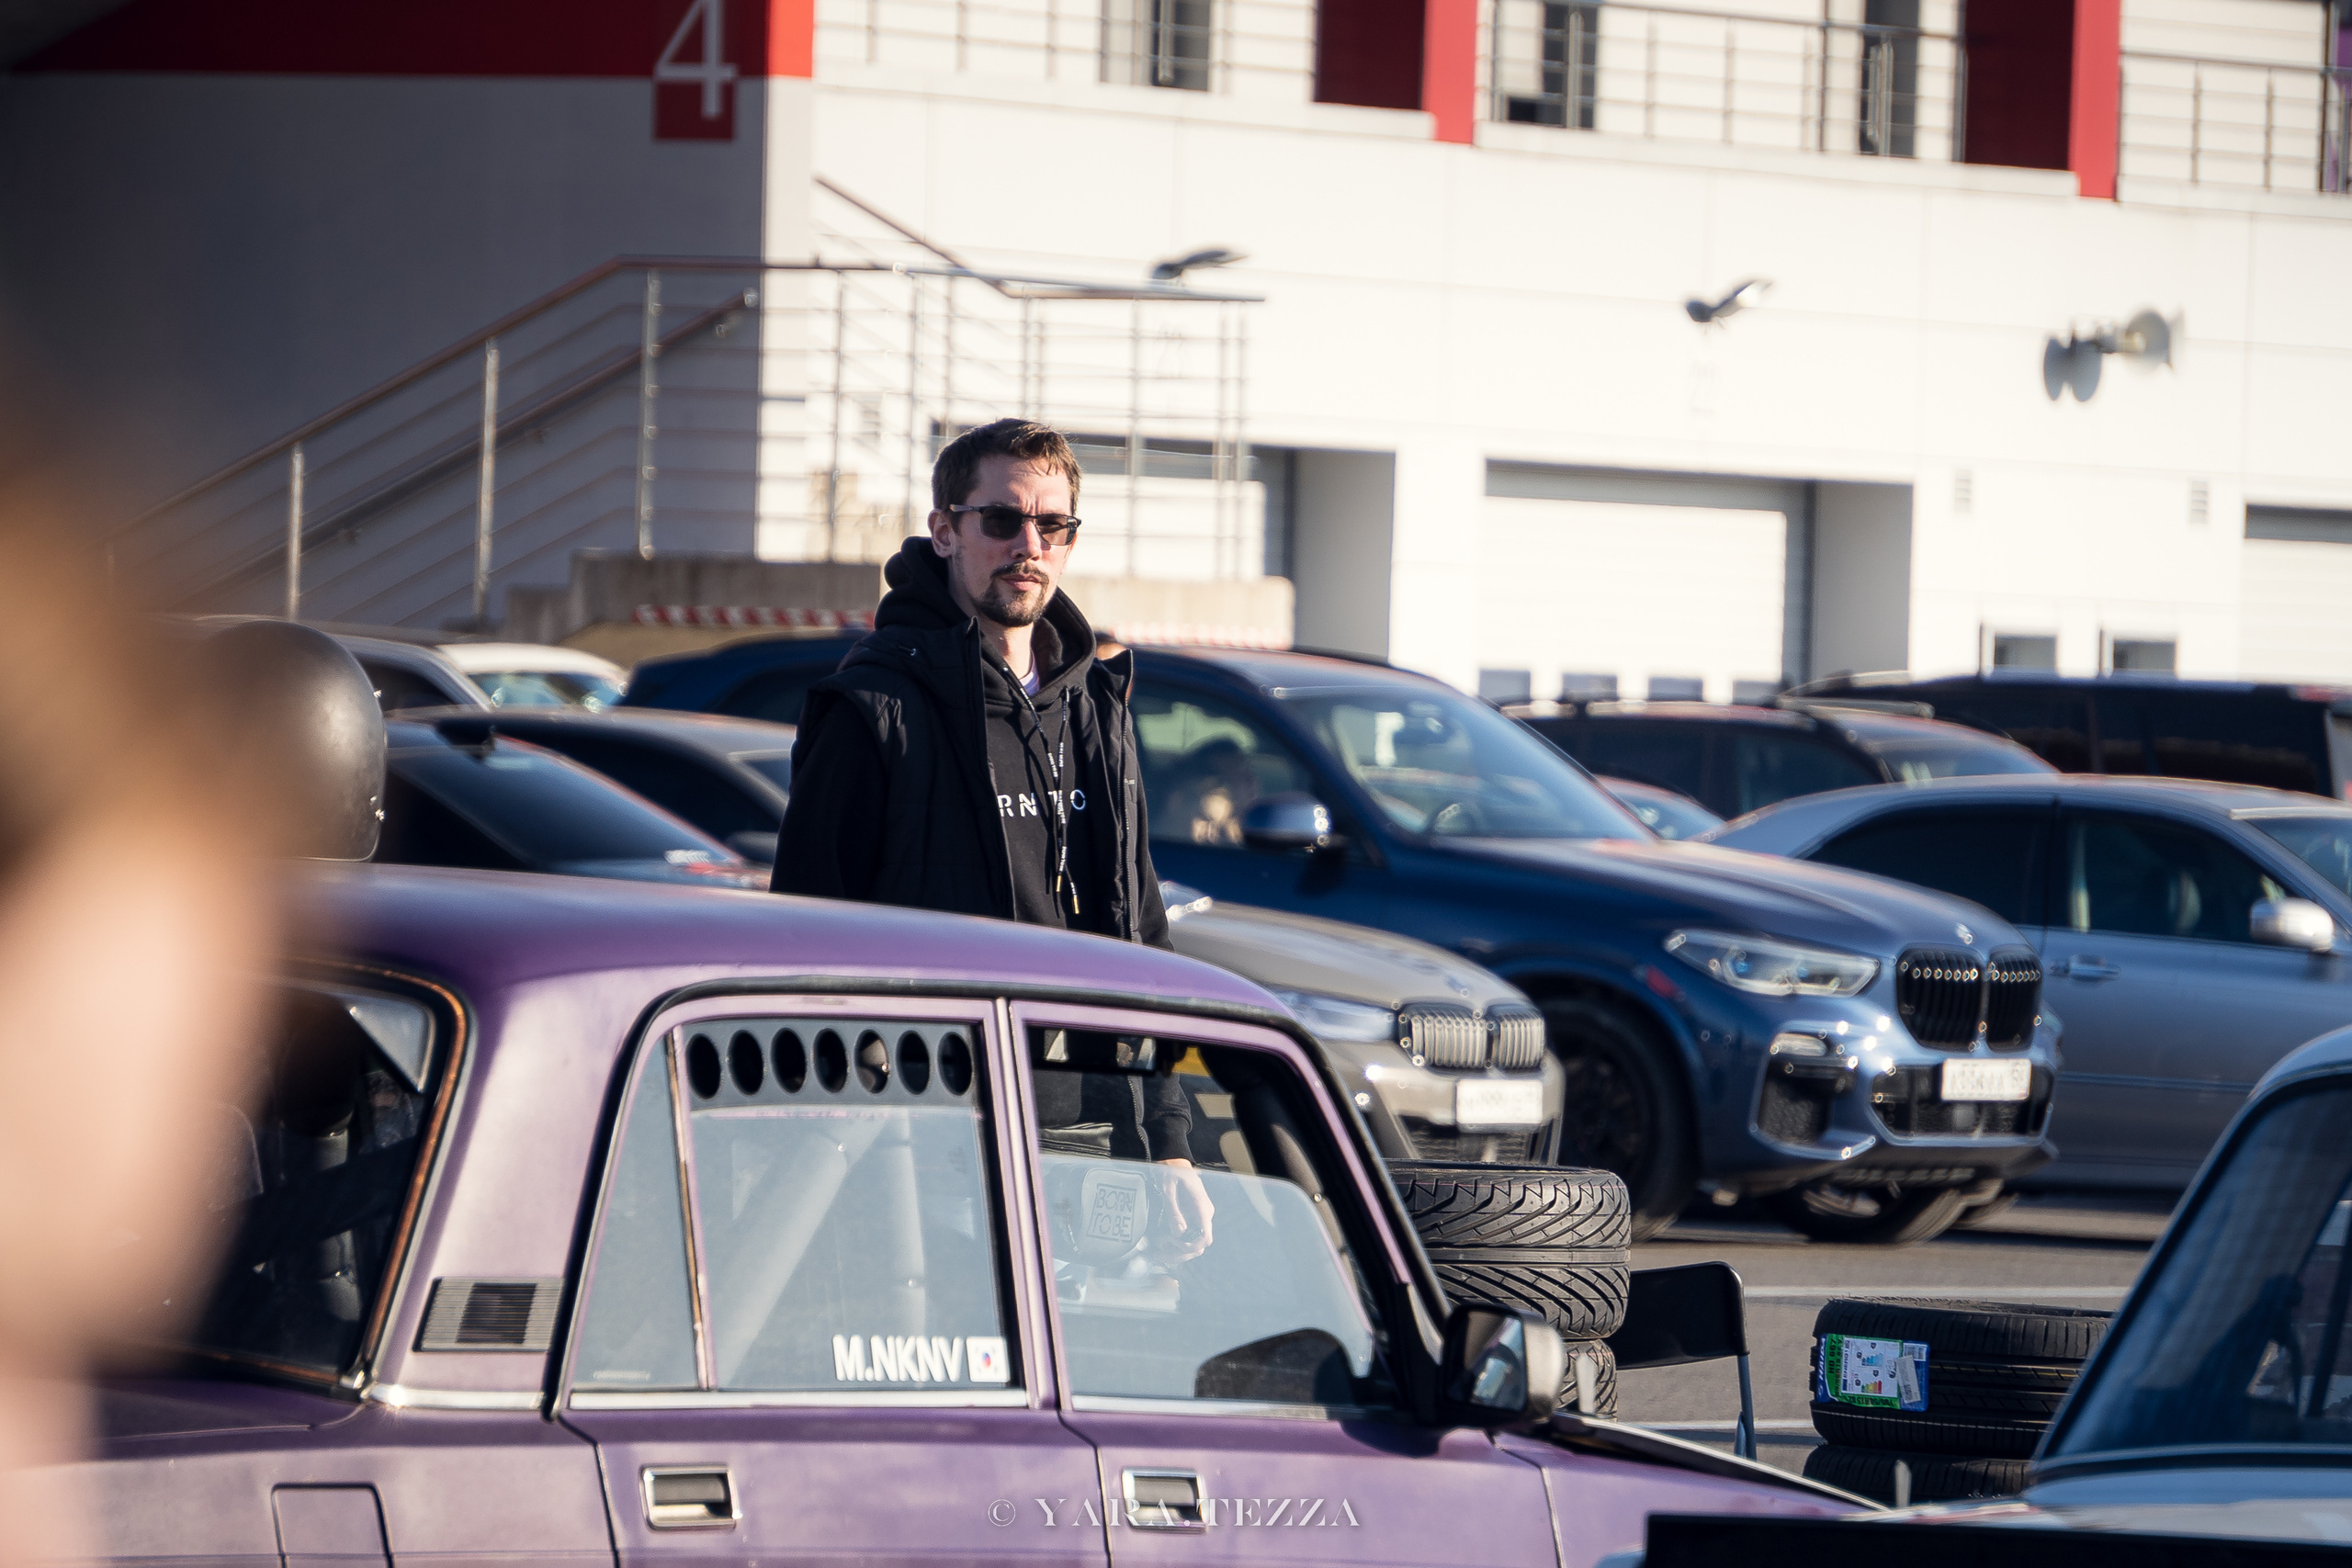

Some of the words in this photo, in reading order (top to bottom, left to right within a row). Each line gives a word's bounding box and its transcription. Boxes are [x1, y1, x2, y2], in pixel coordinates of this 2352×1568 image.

[655, 0, 736, 118] 4
[1097, 1189, 1133, 1213] BORN
[1092, 1213, 1112, 1235] TO
[1113, 1216, 1131, 1237] BE
[832, 1334, 963, 1382] M.NKNV
[1828, 1359, 1836, 1374] HD
